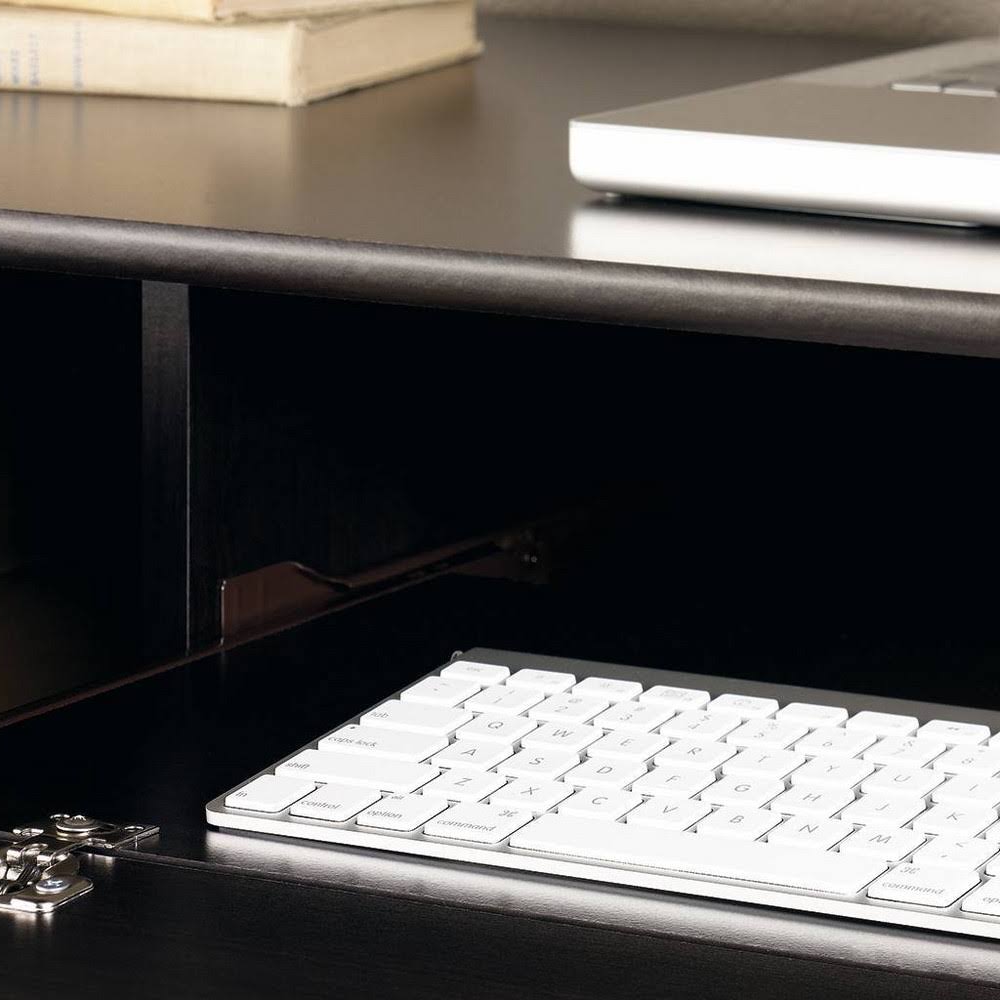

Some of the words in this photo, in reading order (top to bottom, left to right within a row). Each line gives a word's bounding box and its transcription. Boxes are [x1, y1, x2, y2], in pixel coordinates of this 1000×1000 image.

[487, 721, 505, 731] Q
[552, 729, 574, 738] W
[459, 748, 478, 757] A
[686, 746, 703, 755] R
[528, 757, 545, 766] S
[595, 766, 613, 775] D
[453, 777, 473, 786] Z
[664, 775, 682, 784] F
[893, 773, 912, 783] U
[520, 786, 541, 796] X
[733, 783, 751, 793] G
[236, 790, 249, 798] fn
[802, 793, 824, 802] H
[300, 799, 343, 811] control
[591, 796, 609, 806] C
[366, 809, 404, 821] option
[662, 805, 679, 815] V
[729, 815, 745, 825] B
[946, 811, 966, 821] K
[436, 819, 498, 833] command
[798, 823, 820, 833] N
[868, 834, 892, 844] M
[881, 881, 947, 896] command
